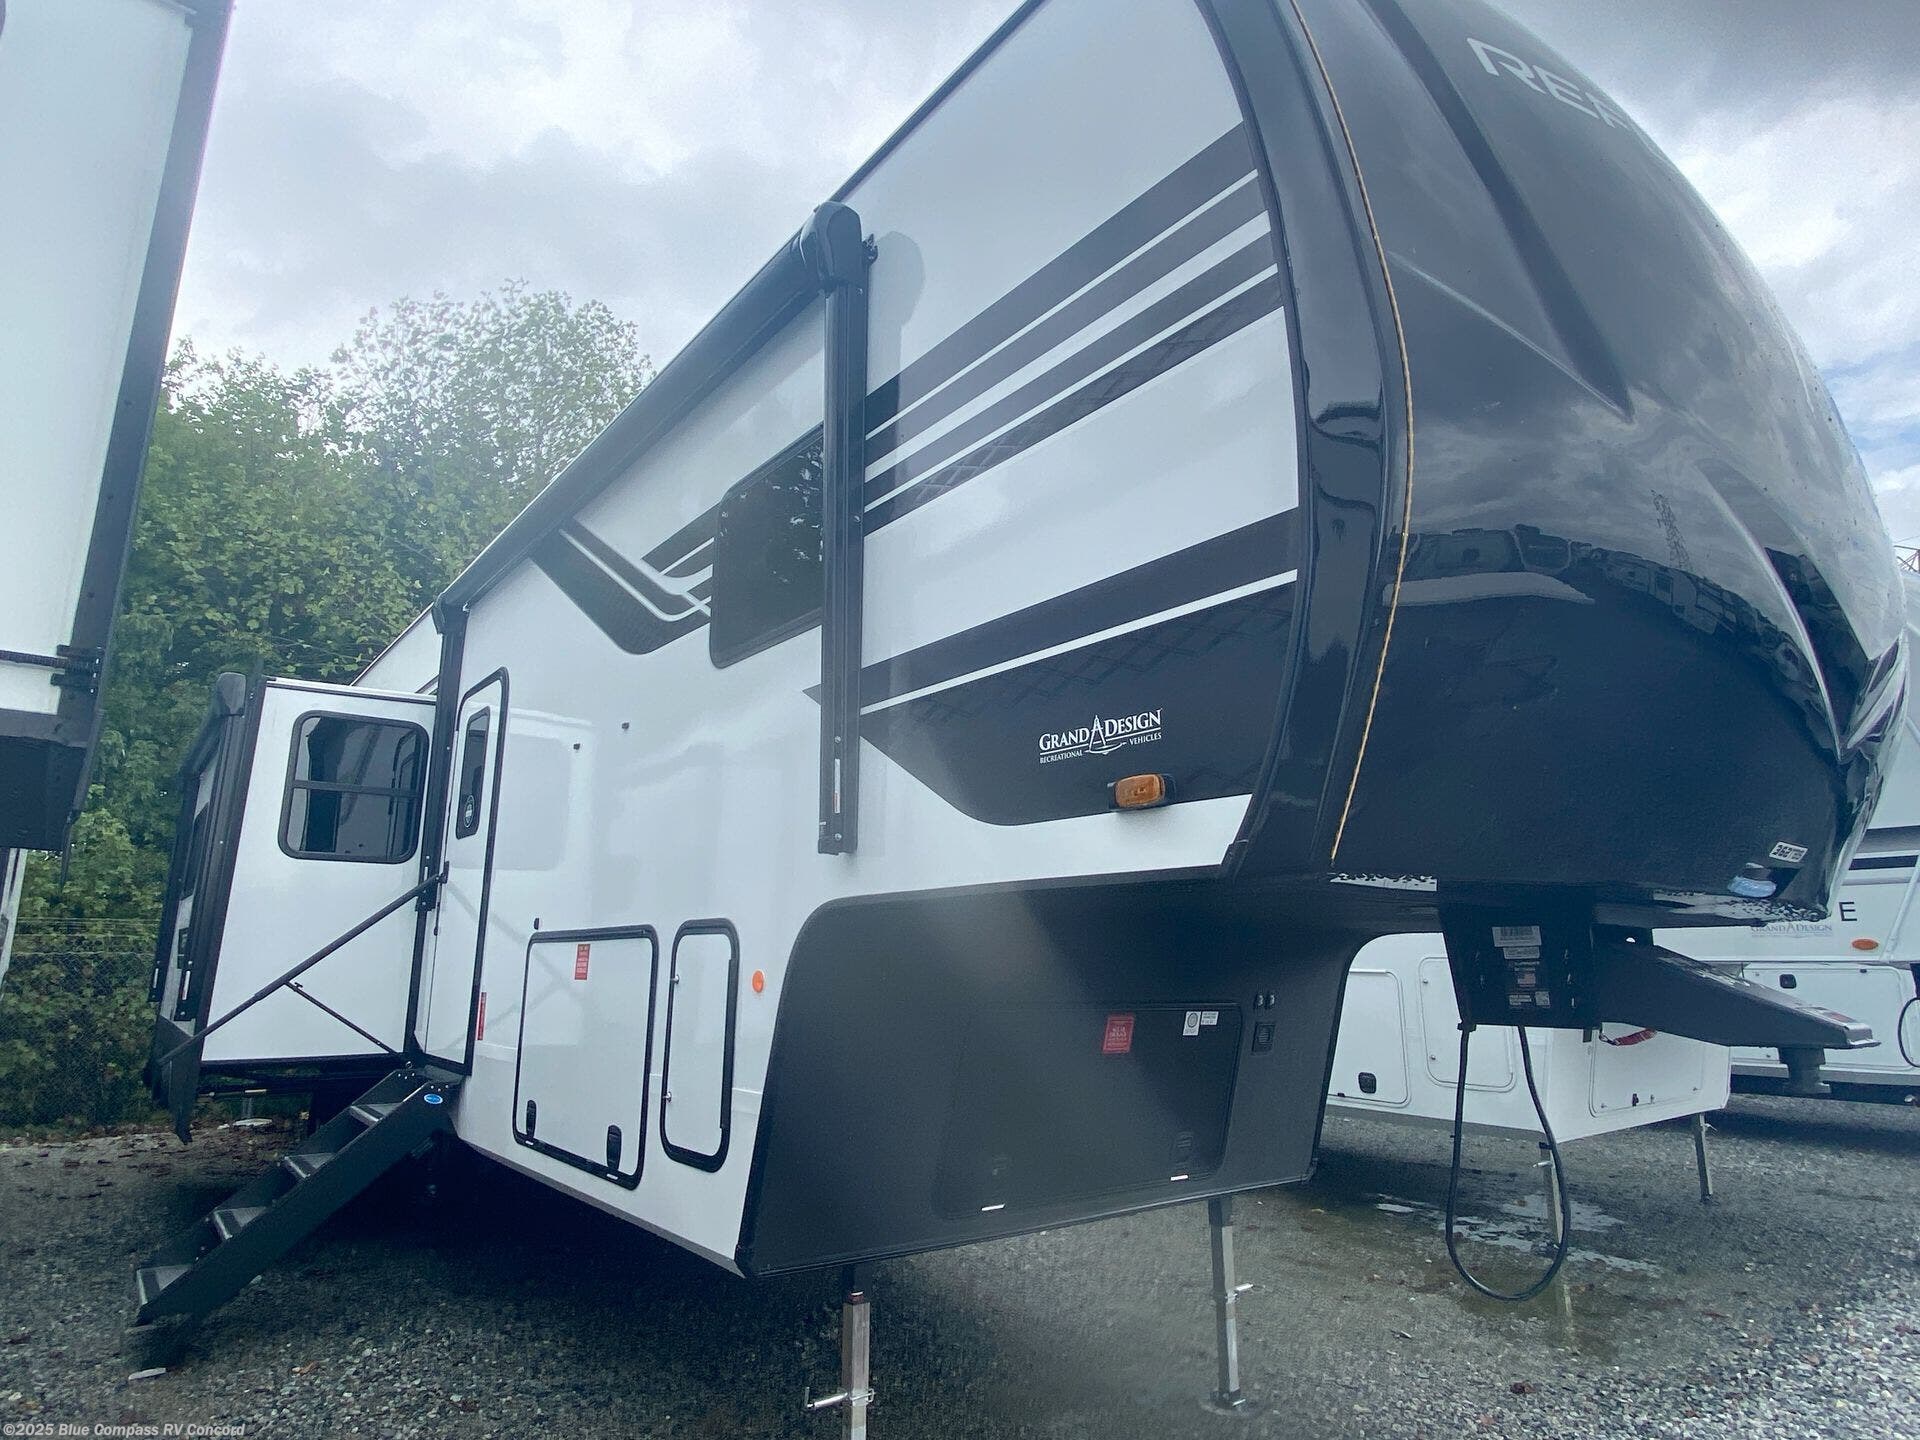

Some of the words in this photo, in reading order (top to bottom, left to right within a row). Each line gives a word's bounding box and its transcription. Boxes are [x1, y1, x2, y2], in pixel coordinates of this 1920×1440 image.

[1466, 37, 1648, 146] REF
[1039, 727, 1090, 751] GRAND
[1104, 708, 1162, 738] DESIGN
[1040, 749, 1083, 764] RECREATIONAL
[1129, 732, 1162, 746] VEHICLES
